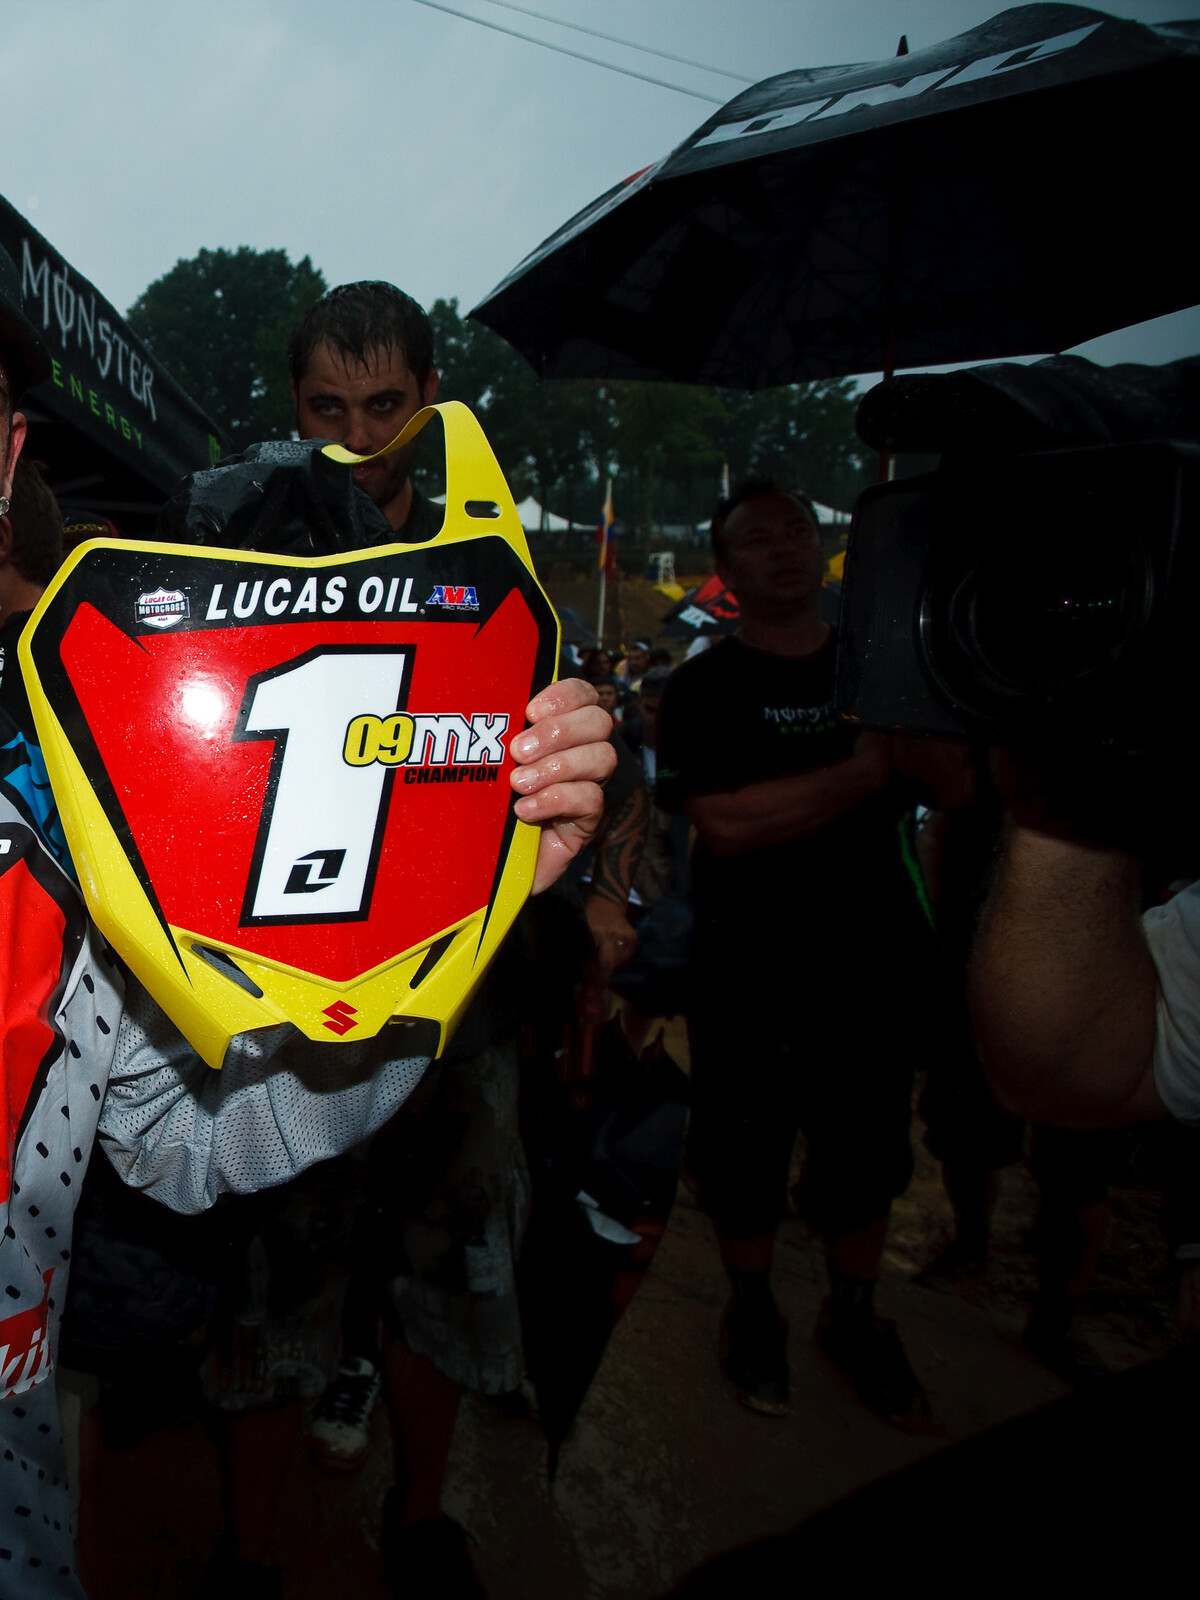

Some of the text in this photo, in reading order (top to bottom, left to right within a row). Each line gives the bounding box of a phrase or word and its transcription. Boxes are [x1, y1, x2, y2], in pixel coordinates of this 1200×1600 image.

[50, 357, 144, 449] ENERGY
[138, 601, 186, 615] MOTOCROSS
[204, 575, 419, 620] LUCAS OIL
[425, 585, 480, 606] AMA
[241, 650, 410, 919] 1
[404, 766, 499, 784] CHAMPION
